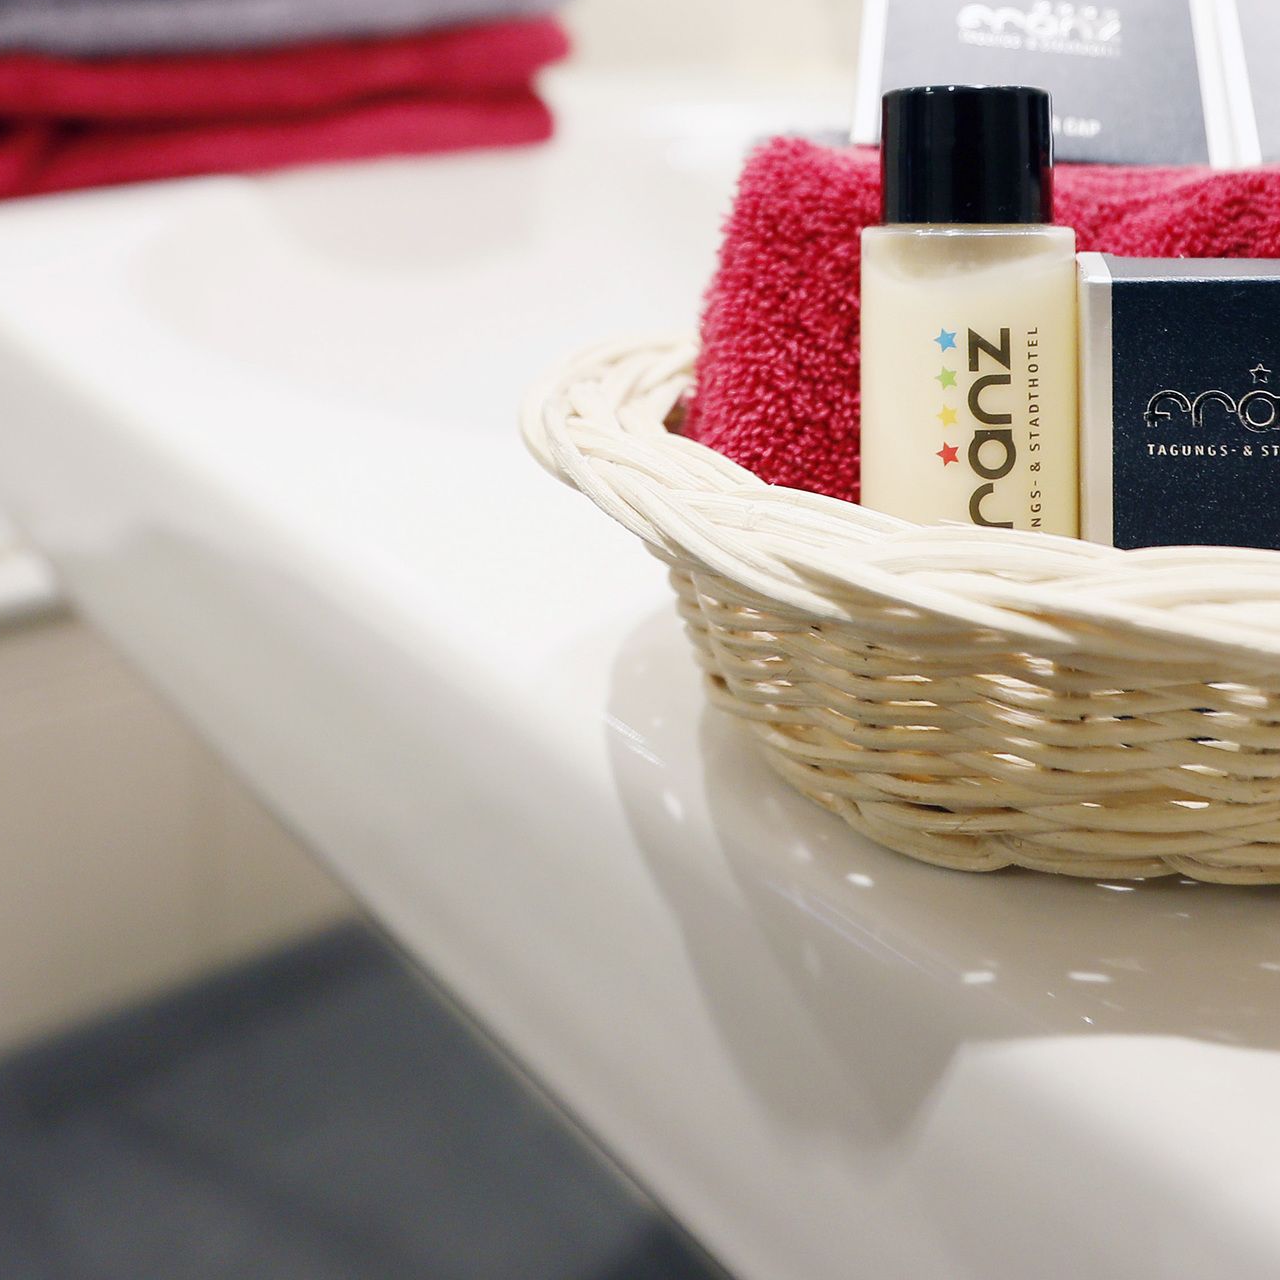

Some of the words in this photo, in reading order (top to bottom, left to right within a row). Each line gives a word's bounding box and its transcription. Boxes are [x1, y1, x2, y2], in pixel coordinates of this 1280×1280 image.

[1027, 327, 1040, 452] STADTHOTEL
[968, 328, 1016, 528] ranz
[1147, 443, 1237, 457] TAGUNGS-
[1243, 444, 1253, 457] &
[1030, 462, 1040, 472] &
[1031, 481, 1041, 528] NGS-
